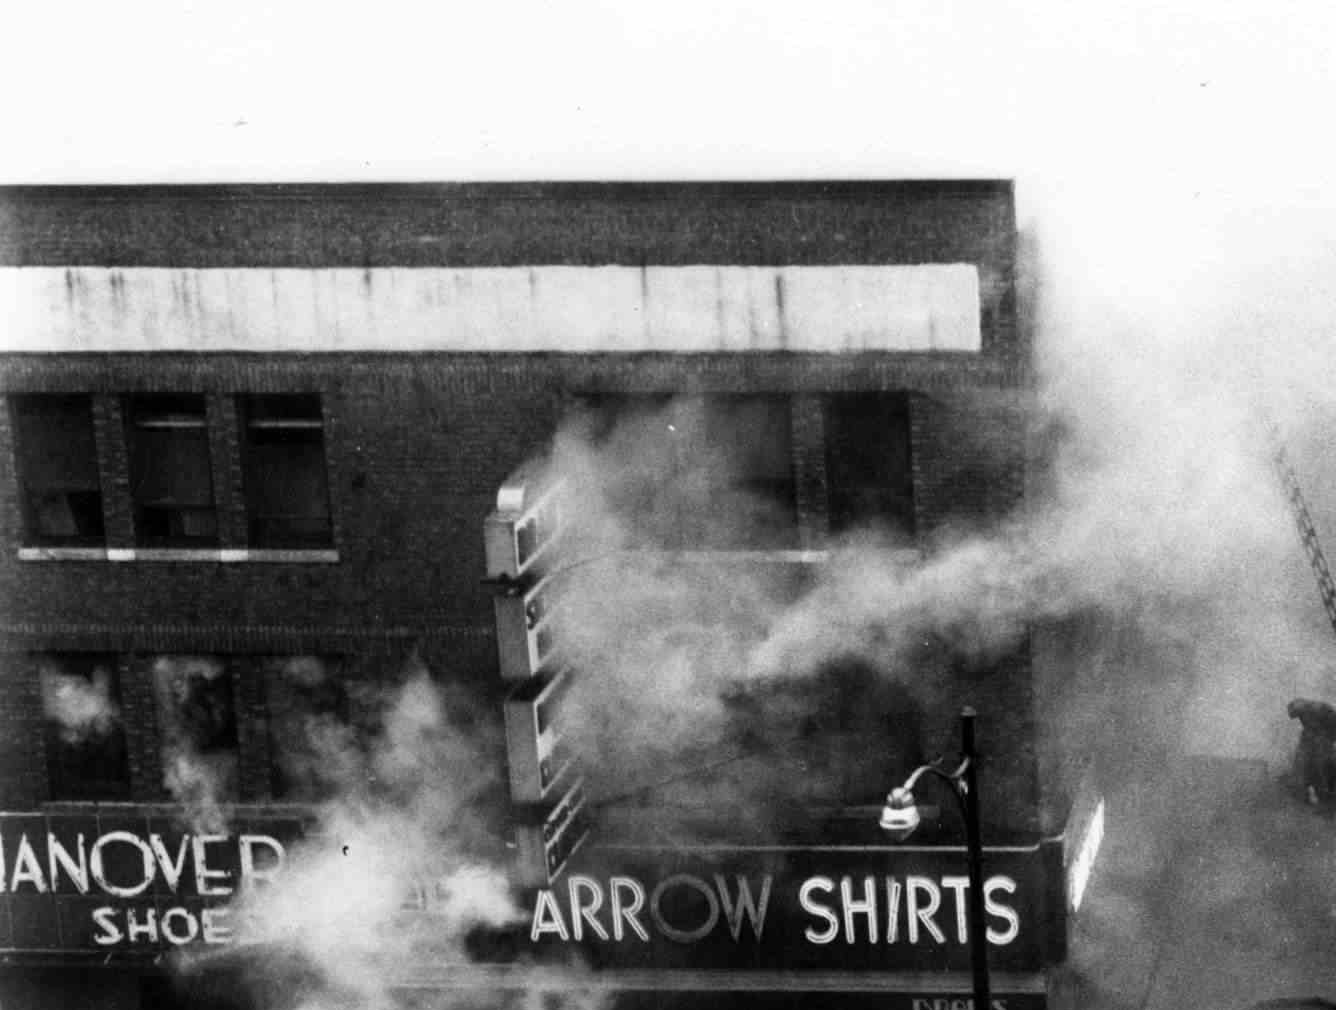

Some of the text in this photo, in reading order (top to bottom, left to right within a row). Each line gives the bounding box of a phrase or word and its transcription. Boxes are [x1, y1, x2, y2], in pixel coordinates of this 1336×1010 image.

[92, 906, 264, 945] SHOE
[530, 875, 772, 943] ARROW
[799, 875, 1021, 945] SHIRTS
